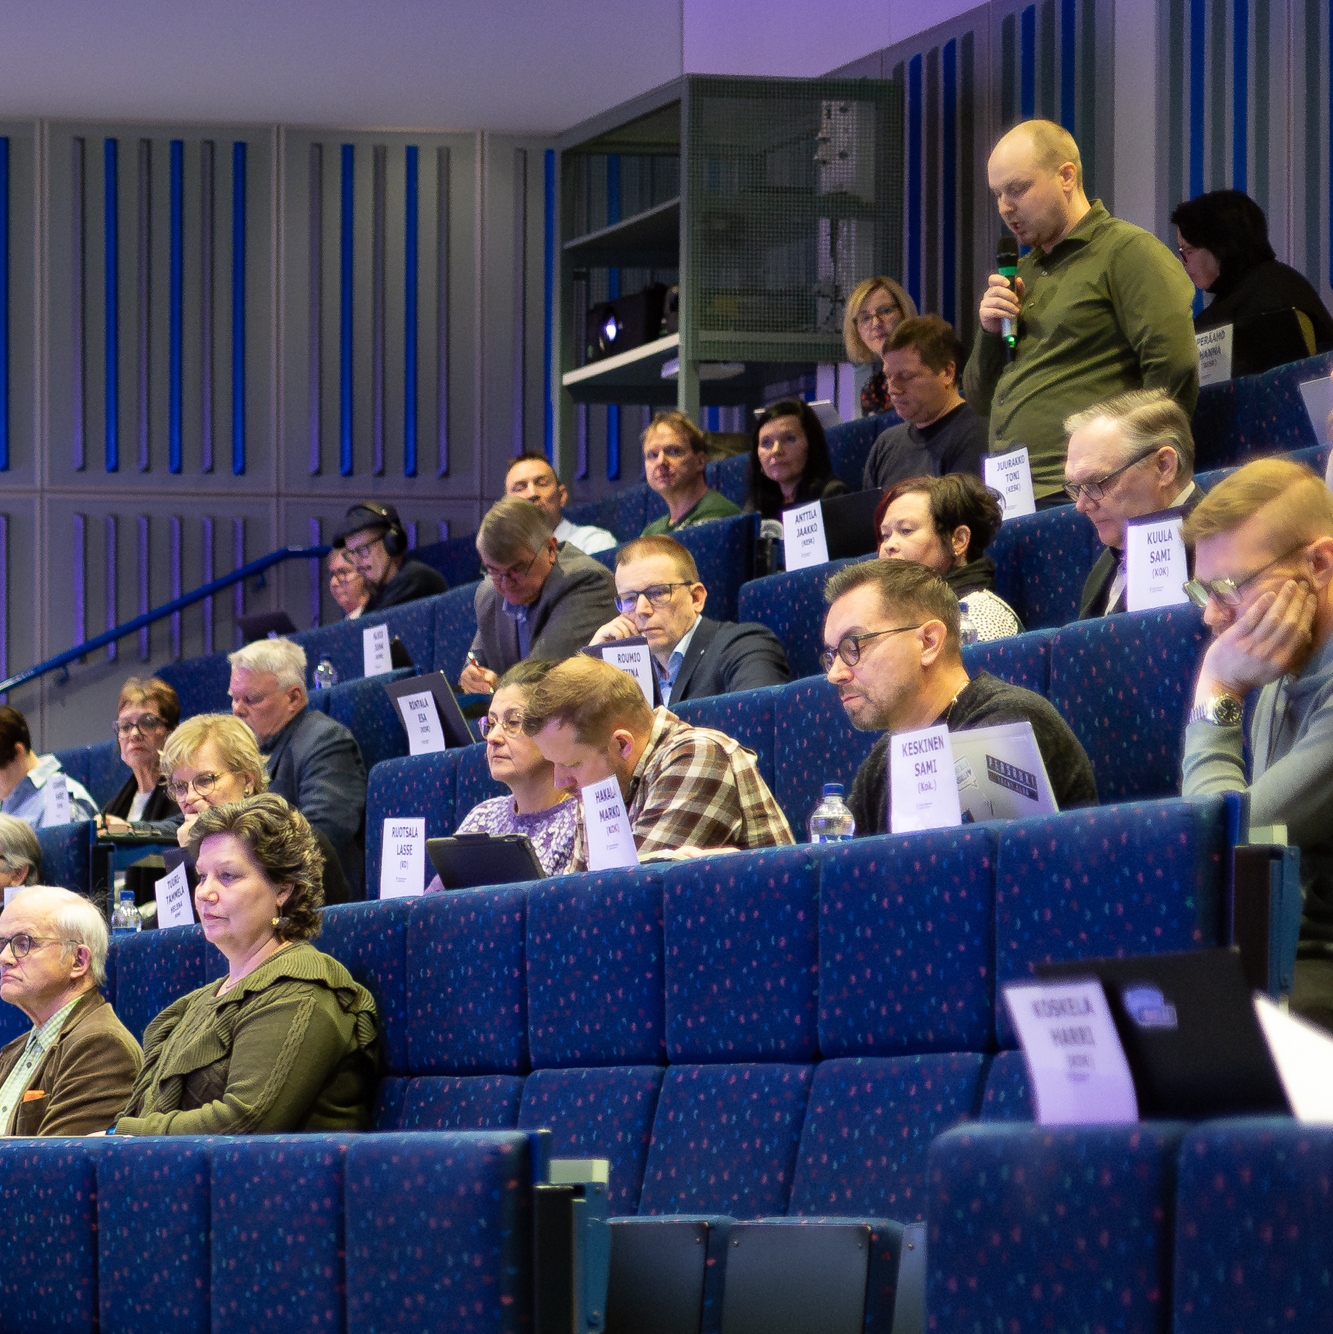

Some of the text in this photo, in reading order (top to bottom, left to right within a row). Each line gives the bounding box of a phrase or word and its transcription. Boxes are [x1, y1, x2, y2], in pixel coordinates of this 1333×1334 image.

[997, 455, 1025, 471] JUURAKKO
[1005, 471, 1020, 482] TONI
[795, 508, 817, 524] ANTTILA
[796, 523, 818, 538] JAAKKO
[1147, 528, 1173, 545] KUULA
[1149, 548, 1171, 564] SAMI
[1152, 566, 1169, 579] (KOK)
[901, 735, 945, 757] KESKINEN
[914, 759, 938, 777] SAMI
[918, 779, 937, 794] (Kok.)
[599, 804, 621, 822] MARKO
[391, 826, 418, 838] RUOTSALA
[396, 844, 413, 855] LASSE
